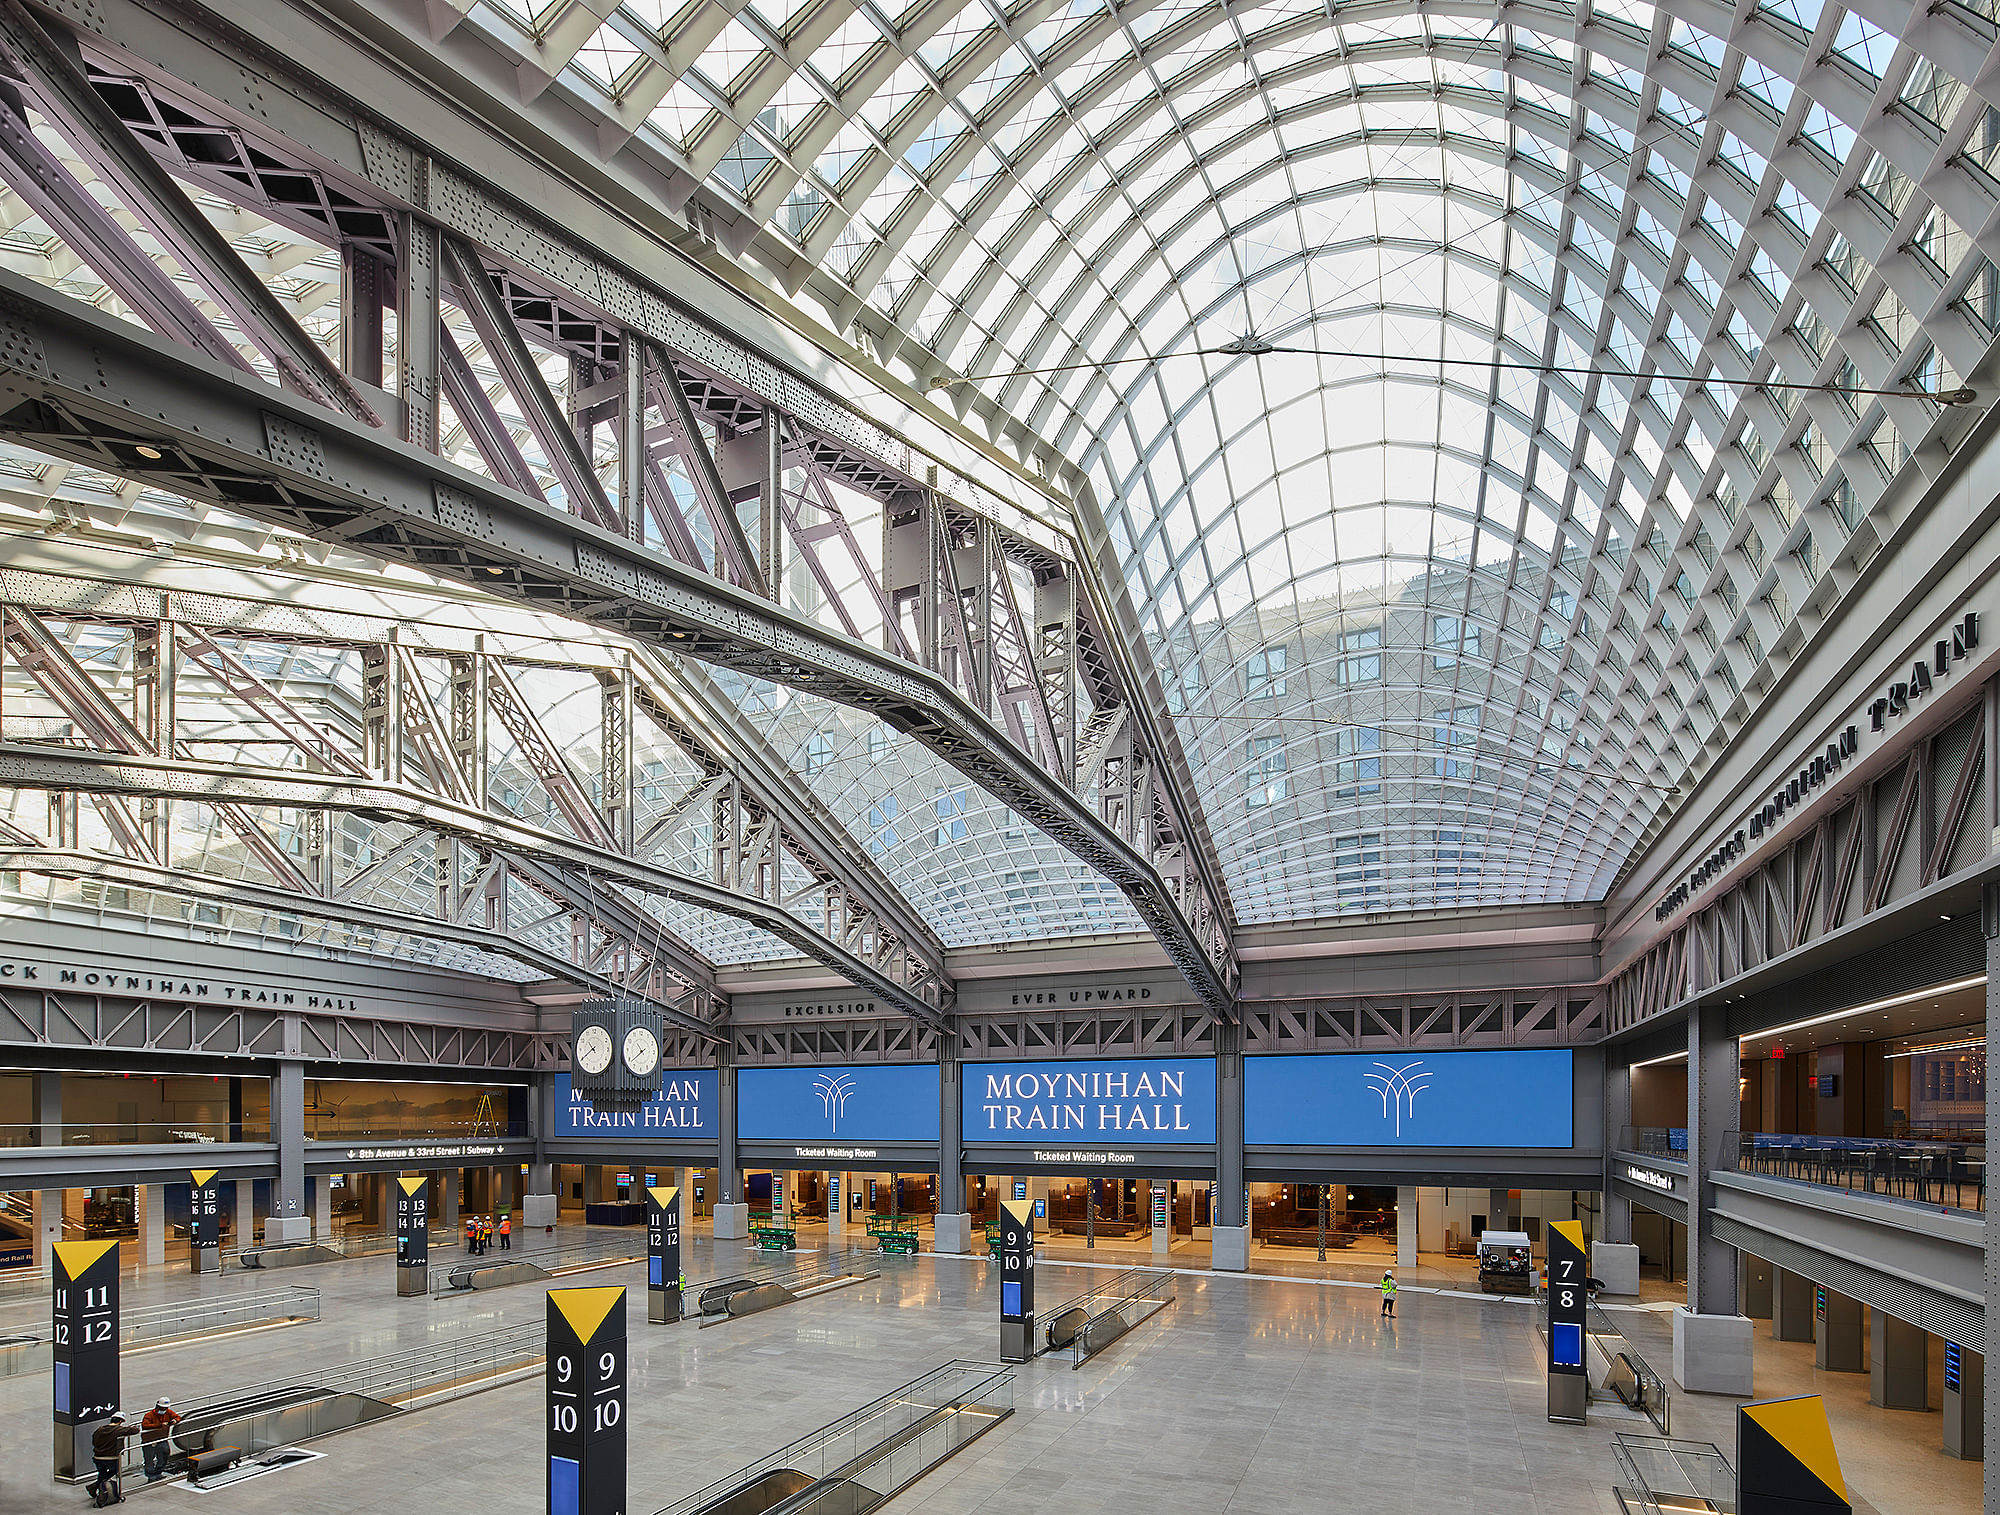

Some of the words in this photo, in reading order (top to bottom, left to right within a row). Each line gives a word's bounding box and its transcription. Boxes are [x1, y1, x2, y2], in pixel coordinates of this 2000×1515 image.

[1750, 725, 1857, 840] MOYNIHAN
[1867, 612, 1978, 732] TRAIN
[60, 969, 208, 996] MOYNIHAN
[225, 987, 294, 1004] TRAIN
[308, 996, 357, 1010] HALL
[1012, 993, 1056, 1005] EVER
[1070, 988, 1151, 1002] UPWARD
[785, 1003, 875, 1016] EXCELSIOR
[986, 1071, 1185, 1099] MOYNIHAN
[568, 1107, 636, 1127] TRAIN
[644, 1106, 704, 1128] HALL
[983, 1104, 1085, 1130] TRAIN
[1098, 1104, 1191, 1130] HALL
[359, 1149, 374, 1159] 8th
[376, 1149, 407, 1158] Avenue
[408, 1148, 415, 1157] &
[416, 1147, 435, 1156] 33rd
[436, 1146, 460, 1156] Street
[467, 1145, 494, 1155] Subway
[795, 1148, 825, 1157] Ticketed
[826, 1148, 854, 1159] Waiting
[855, 1149, 876, 1158] Room
[1034, 1151, 1070, 1161] Ticketed
[1072, 1152, 1106, 1163] Waiting
[1108, 1152, 1134, 1162] Room
[192, 1190, 198, 1200] 15
[204, 1189, 216, 1200] 15
[204, 1204, 216, 1214] 16
[399, 1200, 408, 1211] 13
[414, 1200, 425, 1211] 13
[398, 1218, 408, 1228] 14
[413, 1216, 425, 1228] 14
[651, 1214, 660, 1226] 11
[668, 1212, 676, 1226] 11
[650, 1234, 661, 1246] 12
[668, 1232, 678, 1246] 12
[1007, 1232, 1016, 1246] 9
[1027, 1231, 1032, 1245] 9
[1004, 1256, 1020, 1270] 10
[1026, 1254, 1033, 1270] 10
[1560, 1260, 1574, 1278] 7
[56, 1288, 67, 1310] 11
[84, 1285, 109, 1308] 11
[1560, 1290, 1574, 1308] 8
[56, 1323, 68, 1345] 12
[82, 1320, 112, 1345] 12
[557, 1356, 572, 1382] 9
[599, 1352, 615, 1380] 9
[552, 1404, 578, 1433] 10
[594, 1400, 620, 1432] 10
